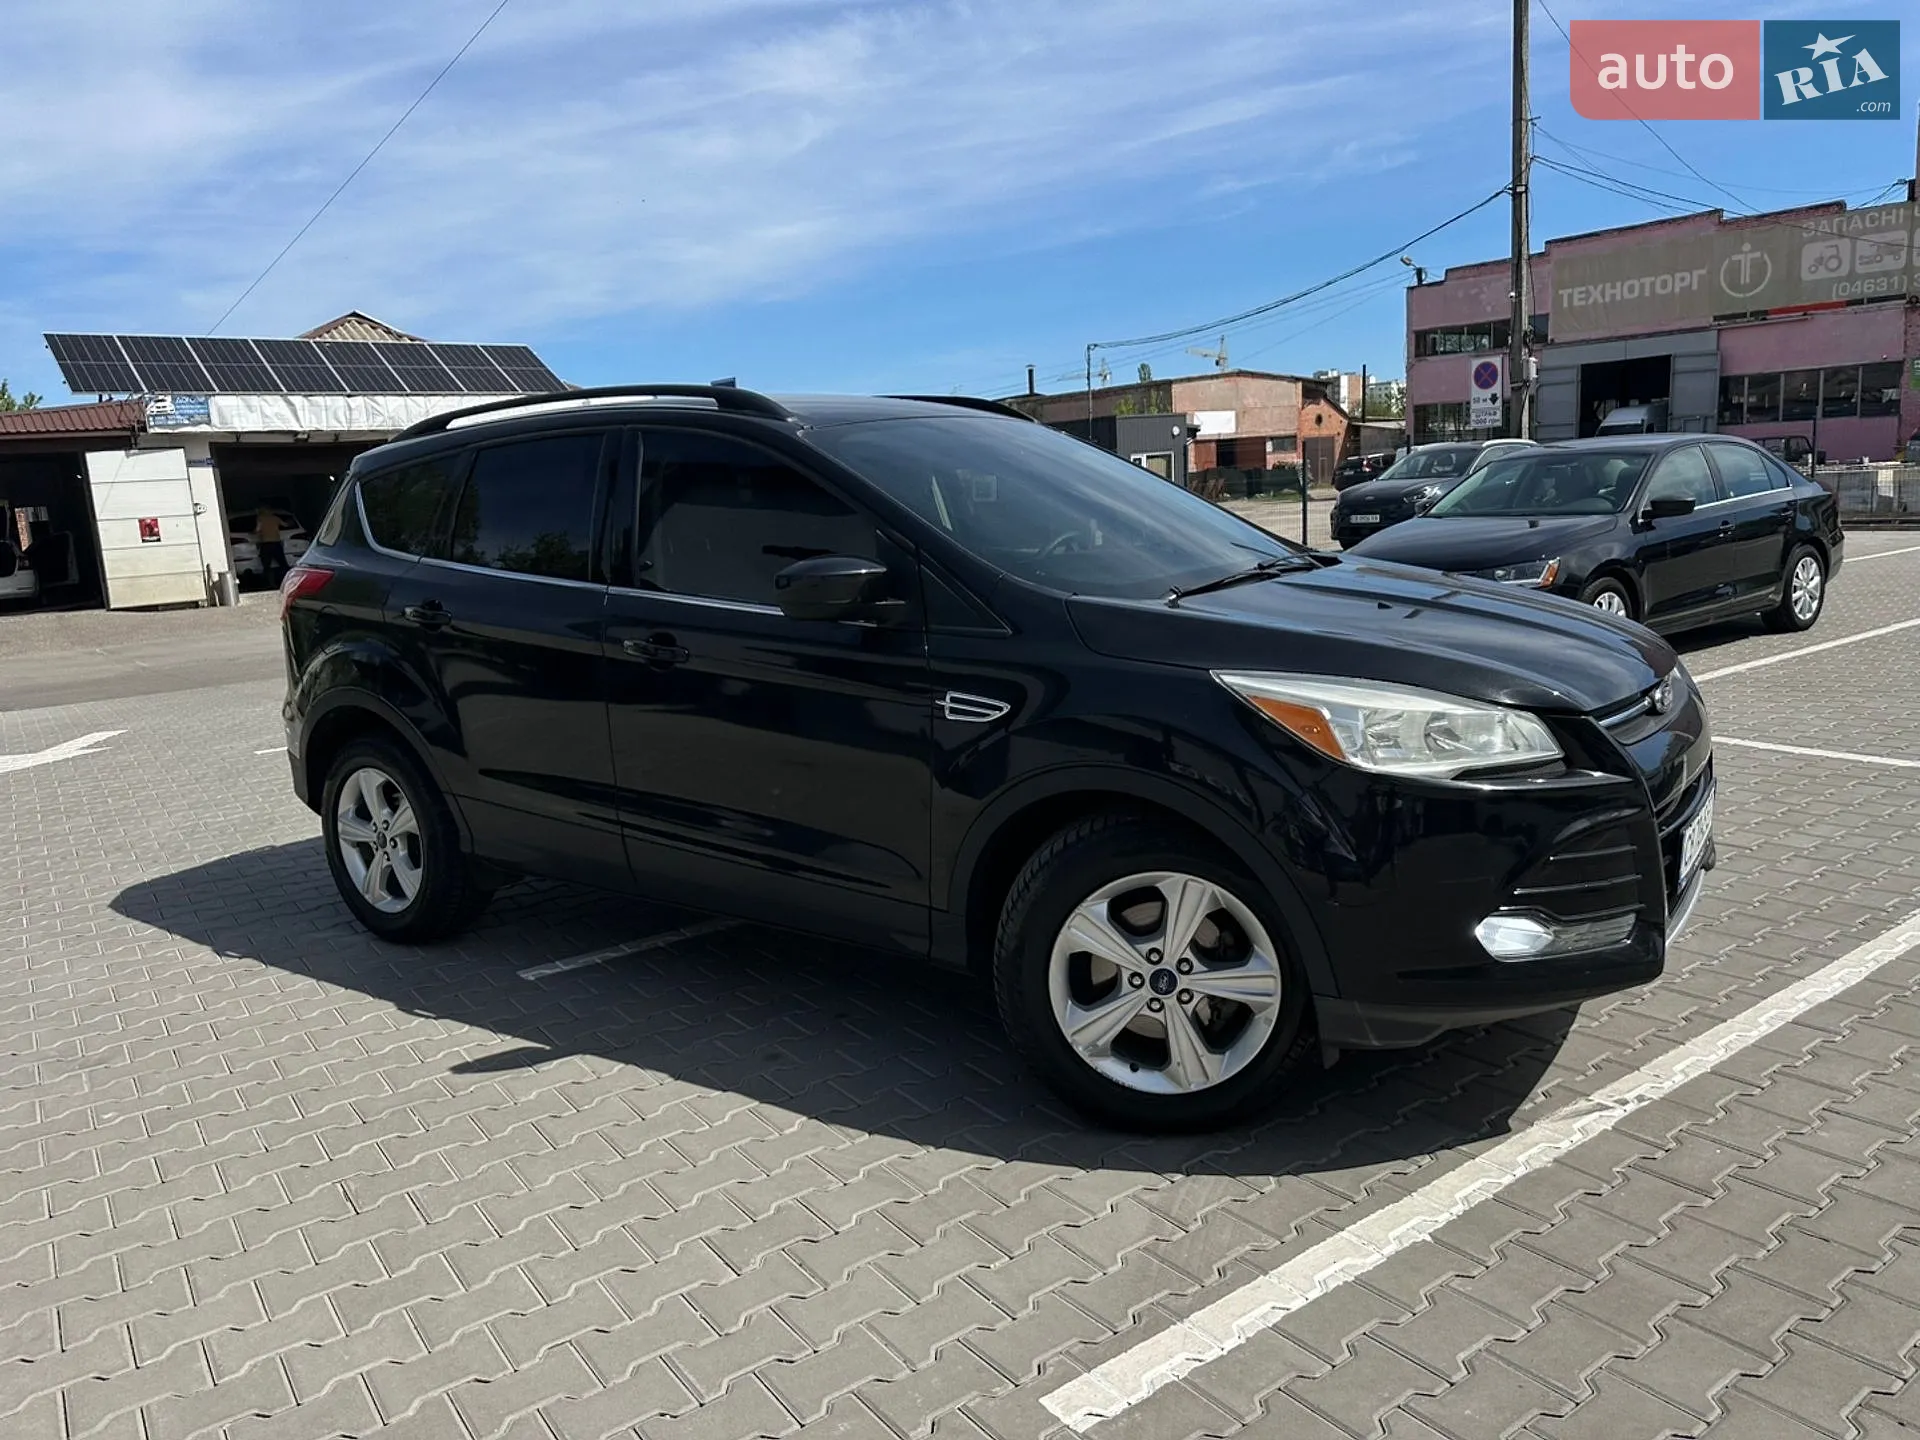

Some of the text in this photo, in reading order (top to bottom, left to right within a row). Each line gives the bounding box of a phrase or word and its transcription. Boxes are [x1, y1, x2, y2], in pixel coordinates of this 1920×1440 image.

[1802, 208, 1904, 238] ЗАПАСНІ
[1558, 267, 1707, 308] ТЕХНОТОРГ
[1832, 275, 1908, 300] (04631)
